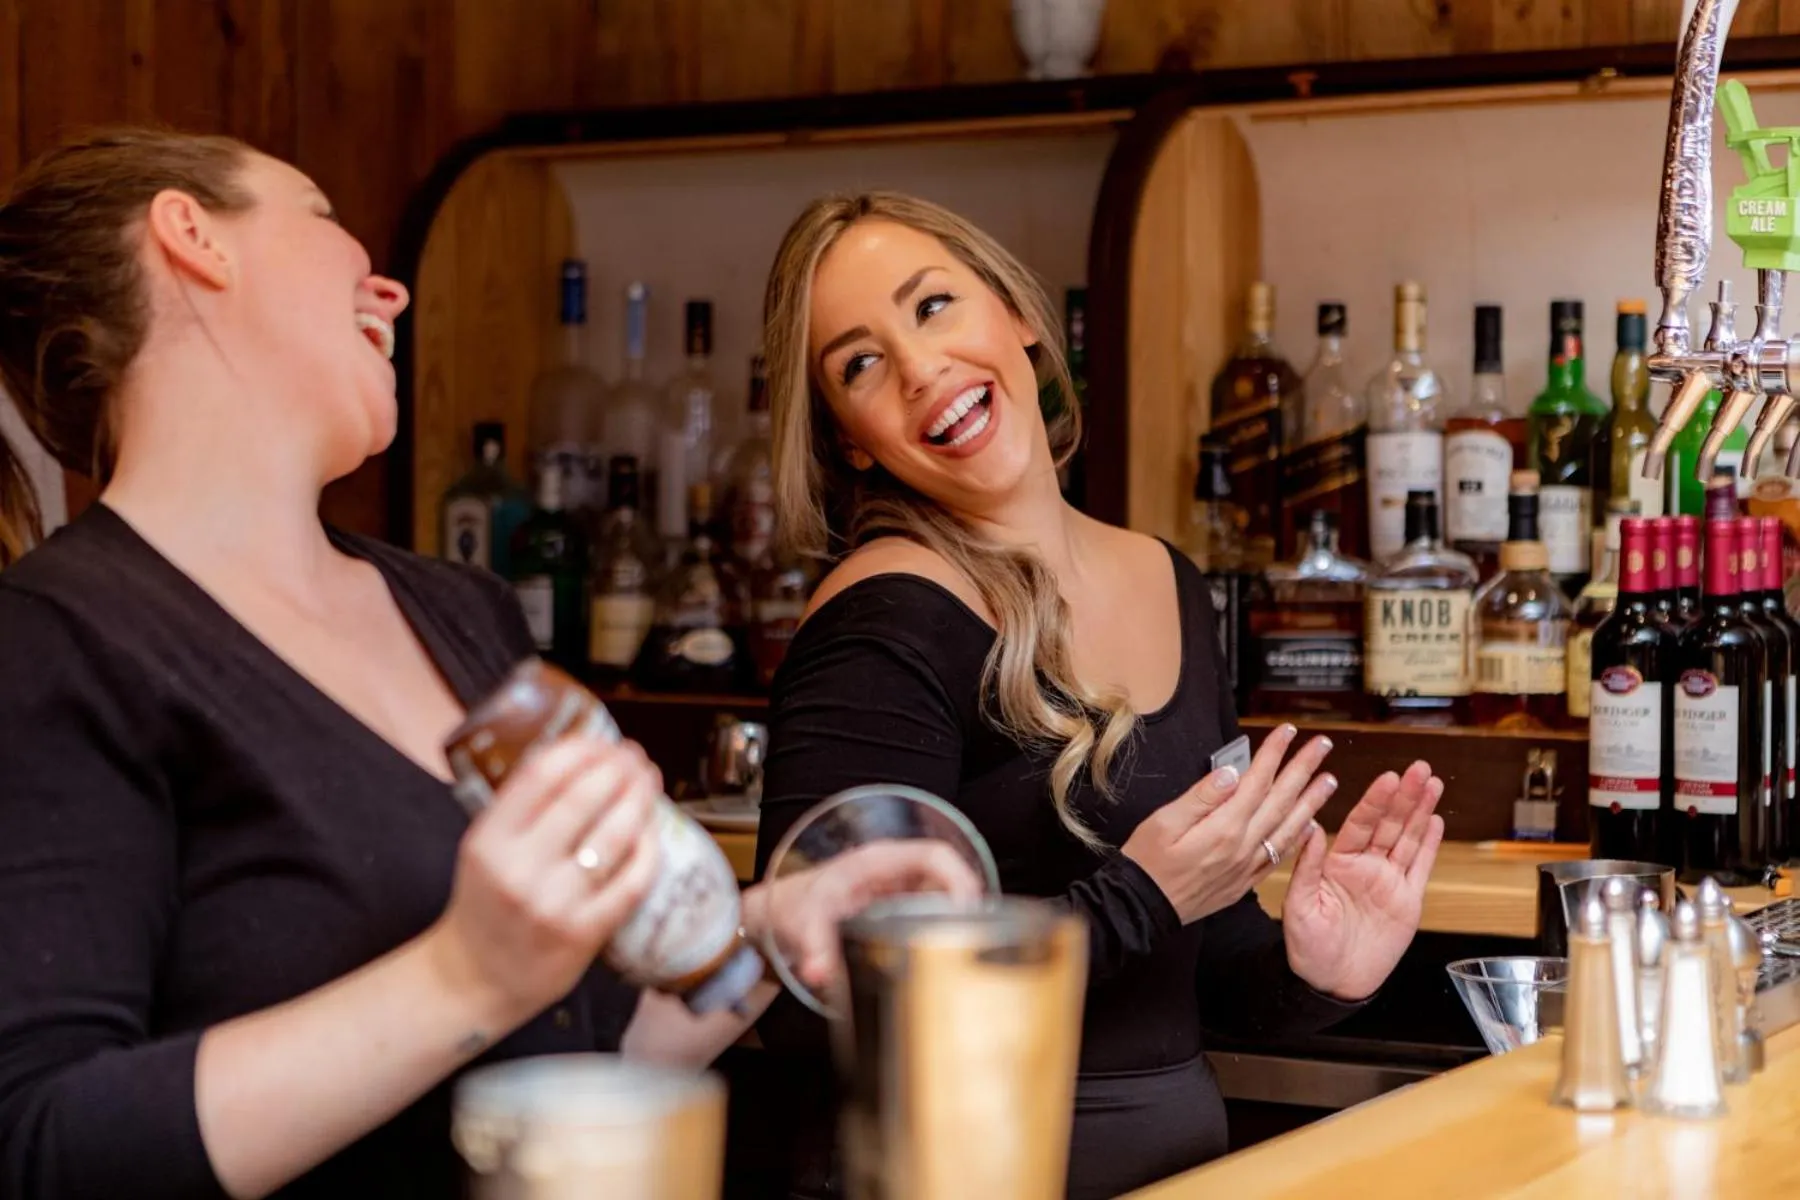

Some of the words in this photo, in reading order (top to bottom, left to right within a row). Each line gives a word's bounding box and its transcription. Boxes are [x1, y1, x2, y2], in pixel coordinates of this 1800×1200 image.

[1739, 200, 1786, 216] CREAM
[1751, 216, 1775, 232] ALE
[1382, 598, 1451, 627] KNOB
